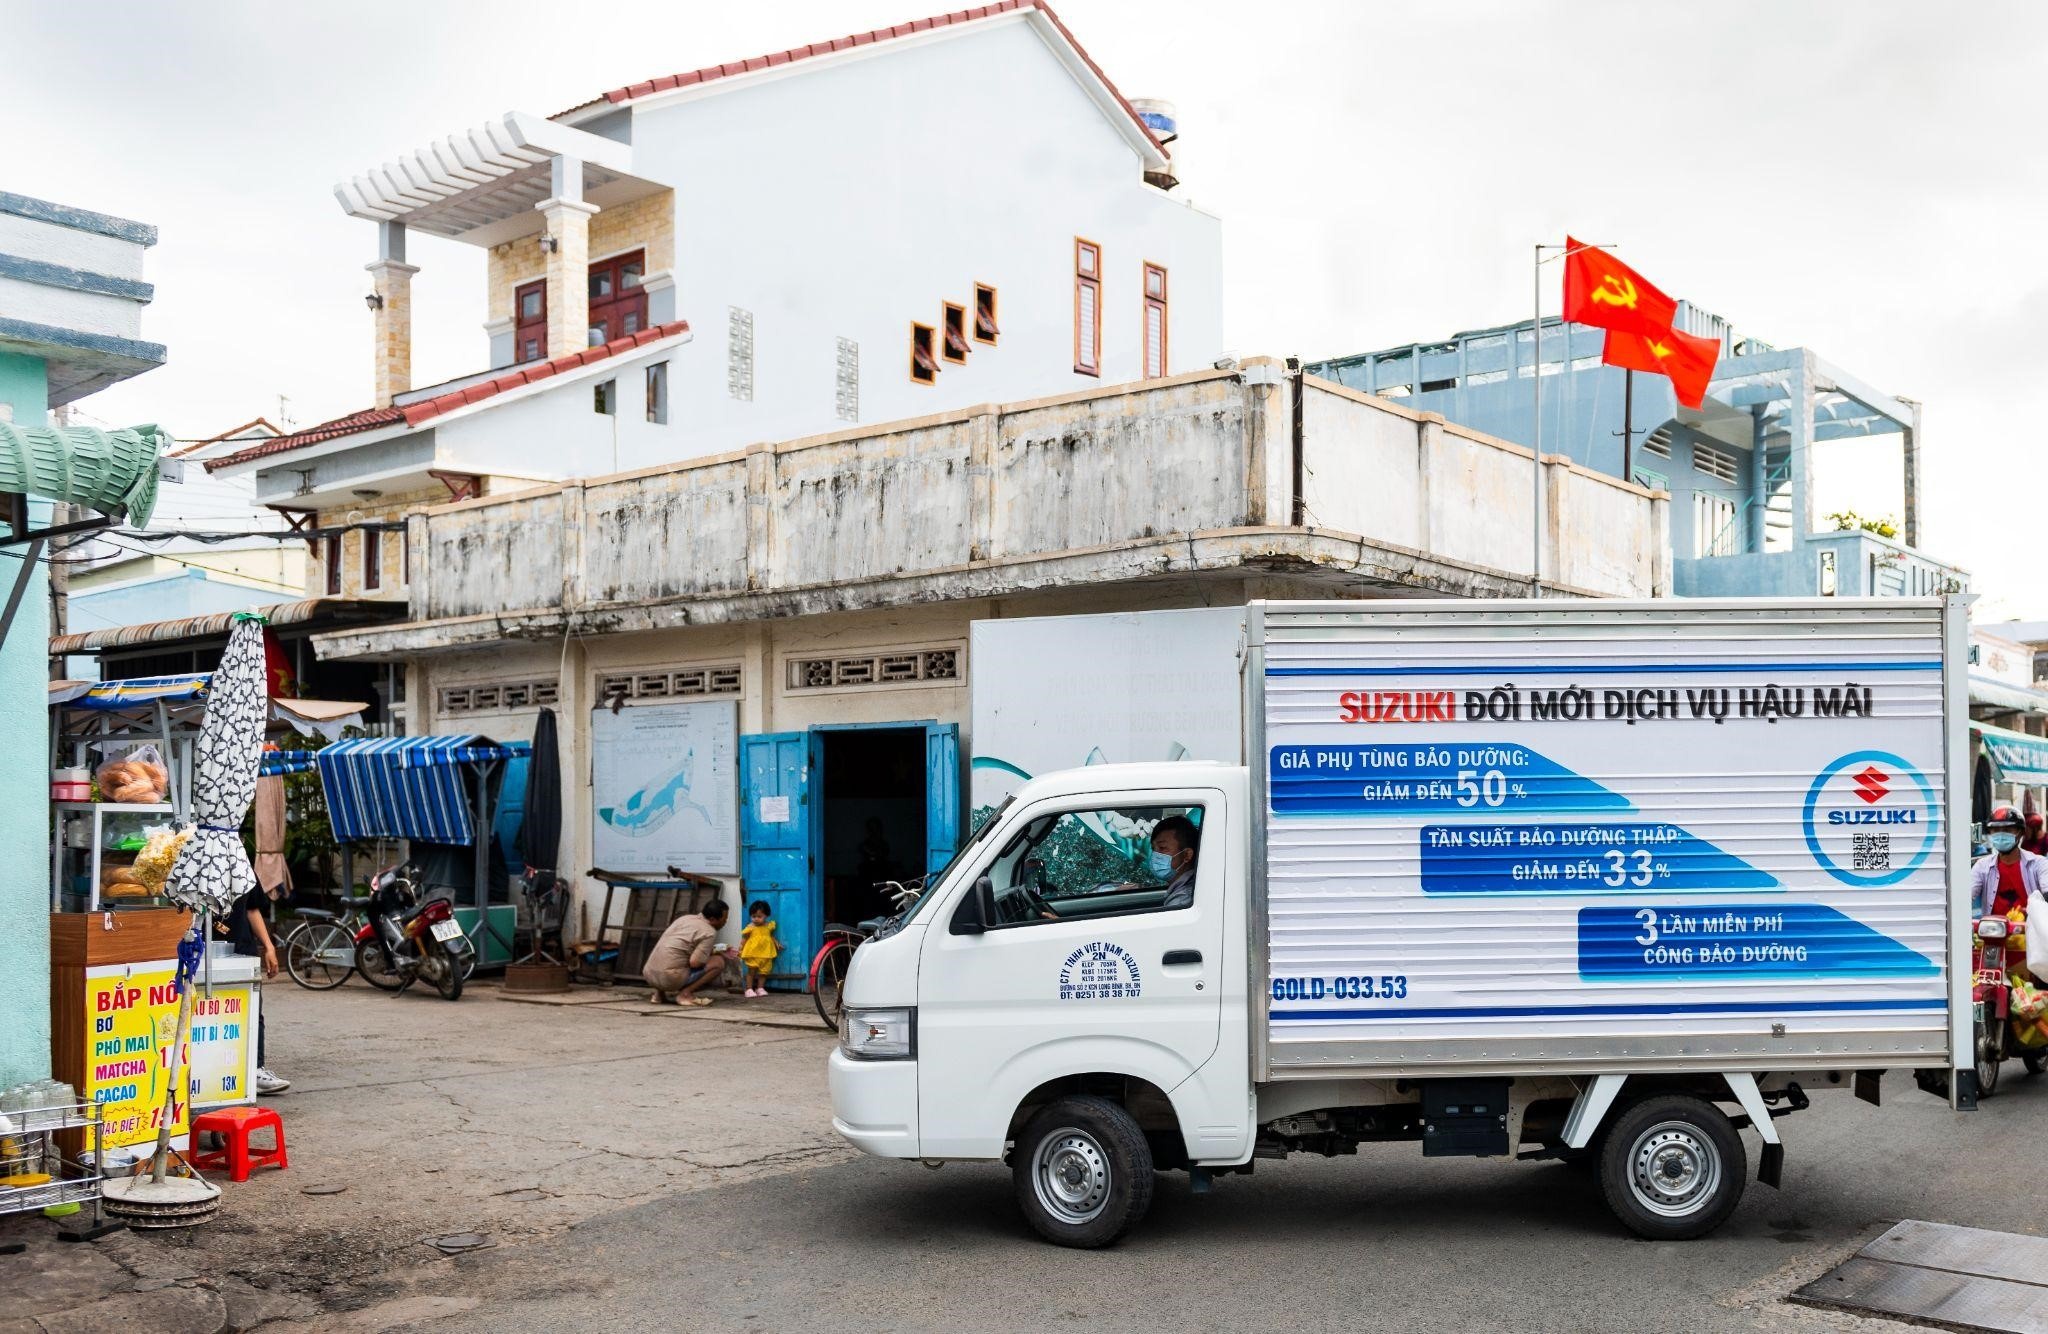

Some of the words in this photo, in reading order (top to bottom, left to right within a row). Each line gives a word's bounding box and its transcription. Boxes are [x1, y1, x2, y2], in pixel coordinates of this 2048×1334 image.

[1339, 691, 1456, 723] SUZUKI
[1464, 682, 1522, 721] ĐỔI
[1531, 683, 1596, 721] MỚI
[1603, 688, 1679, 725] DỊCH
[1686, 688, 1730, 725] VỤ
[1738, 683, 1804, 724] HẬU
[1813, 682, 1873, 718] MÃI
[1279, 749, 1311, 769] GIÁ
[1317, 751, 1352, 771] PHỤ
[1359, 749, 1409, 768] TÙNG
[1414, 746, 1451, 767] BẢO
[1458, 748, 1529, 767] DƯỠNG:
[1363, 780, 1410, 801] GIẢM
[1415, 780, 1452, 800] ĐẾN
[1827, 809, 1916, 825] SUZUKI
[1428, 826, 1463, 848] TẦN
[1468, 827, 1514, 848] SUẤT
[1519, 826, 1555, 847] BẢO
[1561, 826, 1626, 846] DƯỠNG
[1631, 824, 1682, 846] THẤP:
[1512, 859, 1558, 881] GIẢM
[1564, 859, 1600, 880] ĐẾN
[1634, 908, 1659, 946] 3
[1662, 913, 1697, 934] LẦN
[1703, 911, 1747, 933] MIỄN
[1754, 912, 1783, 932] PHÍ
[1065, 948, 1085, 968] TNHH
[1092, 952, 1107, 961] 2N
[1104, 942, 1123, 957] NAM
[1644, 945, 1694, 965] CÔNG
[1699, 942, 1736, 964] BẢO
[1742, 942, 1808, 963] DƯỠNG
[1060, 968, 1071, 984] CTY
[1122, 952, 1141, 982] SUZUKI
[96, 981, 142, 1012] BẮP
[1075, 991, 1096, 999] 0251
[1099, 990, 1110, 998] 38
[1112, 989, 1123, 998] 38
[1125, 989, 1141, 998] 707
[1272, 975, 1408, 1001] 60LD-033.53
[224, 998, 241, 1014] 20K
[96, 1015, 113, 1033] BƠ
[192, 1025, 206, 1046] HỊT
[223, 1023, 240, 1040] 20K
[95, 1038, 121, 1057] PHÔ
[125, 1035, 150, 1053] MAI
[95, 1059, 147, 1081] MATCHA
[95, 1084, 137, 1103] CACAO
[222, 1075, 237, 1092] 13K
